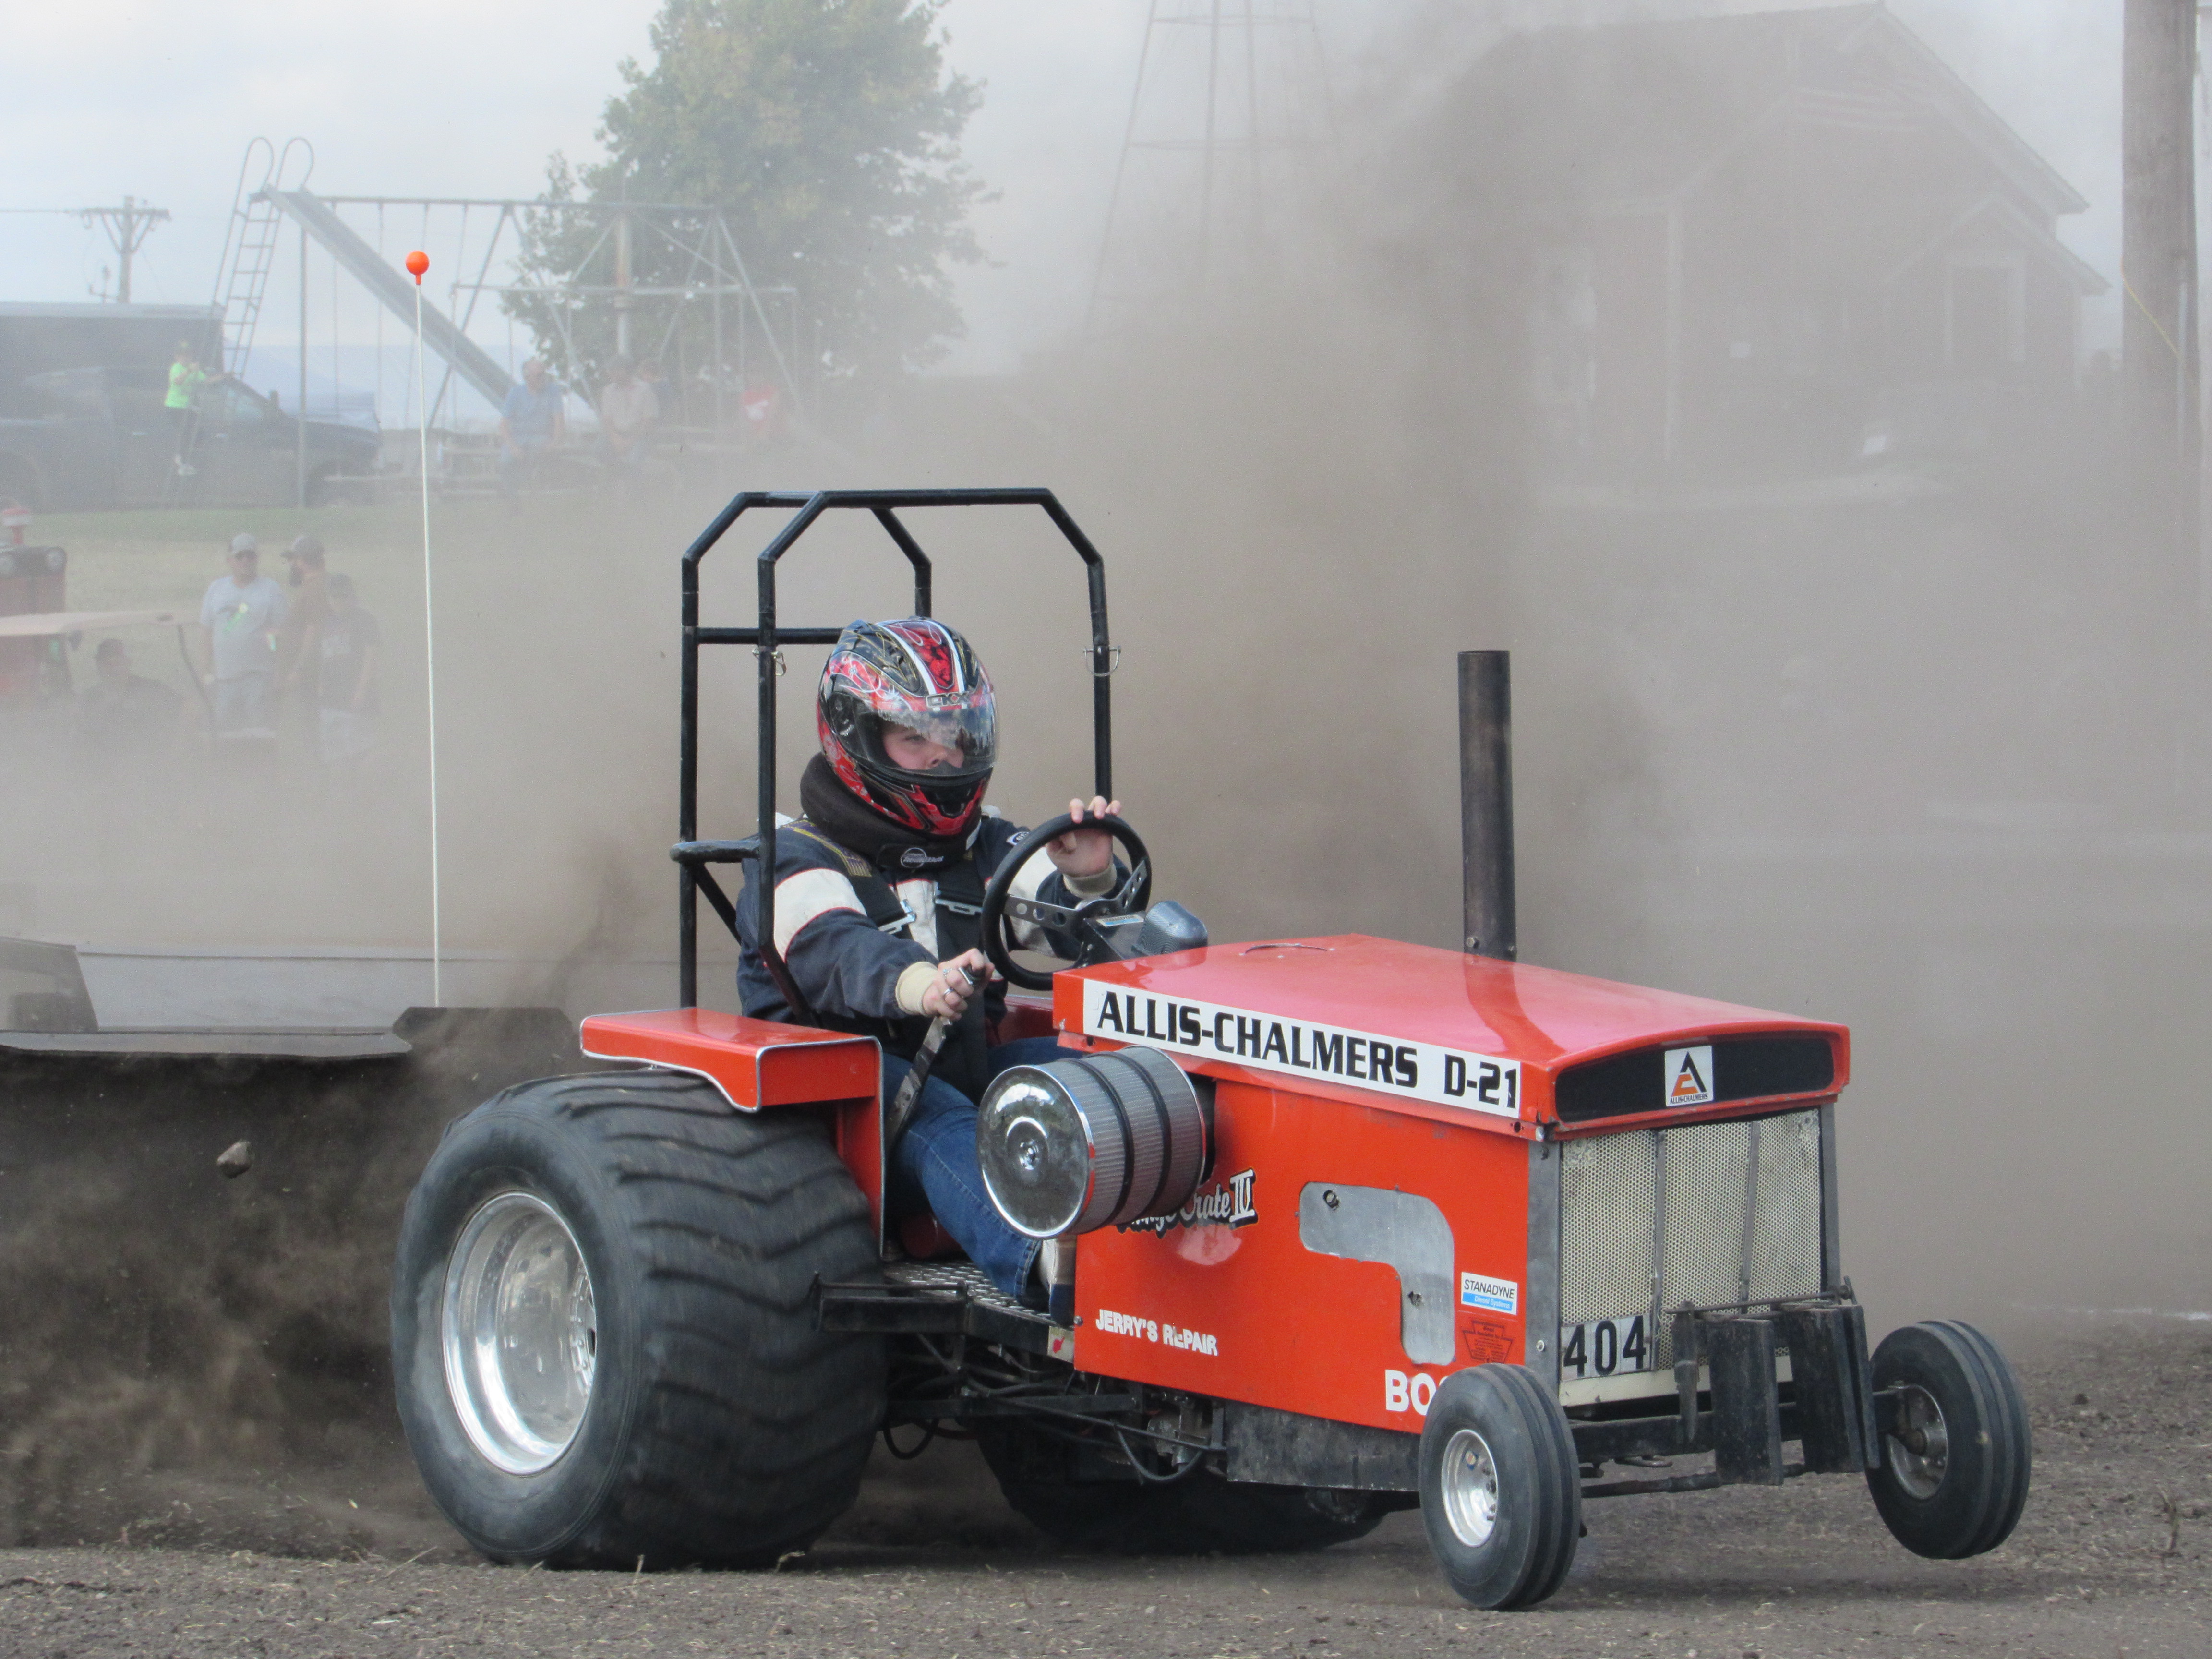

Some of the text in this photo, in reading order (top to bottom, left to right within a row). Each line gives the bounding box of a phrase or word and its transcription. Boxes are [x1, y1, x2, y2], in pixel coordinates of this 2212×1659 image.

[1097, 991, 1517, 1109] ALLIS-CHALMERS D-21
[1670, 1093, 1708, 1104] ALLIS-CHALMERS
[1464, 1279, 1515, 1299] STANADYNE
[1474, 1295, 1511, 1309] Diesel Systems
[1096, 1309, 1218, 1357] JERRY'S REPAIR
[1563, 1315, 1647, 1377] 404
[1385, 1369, 1448, 1416] BO
